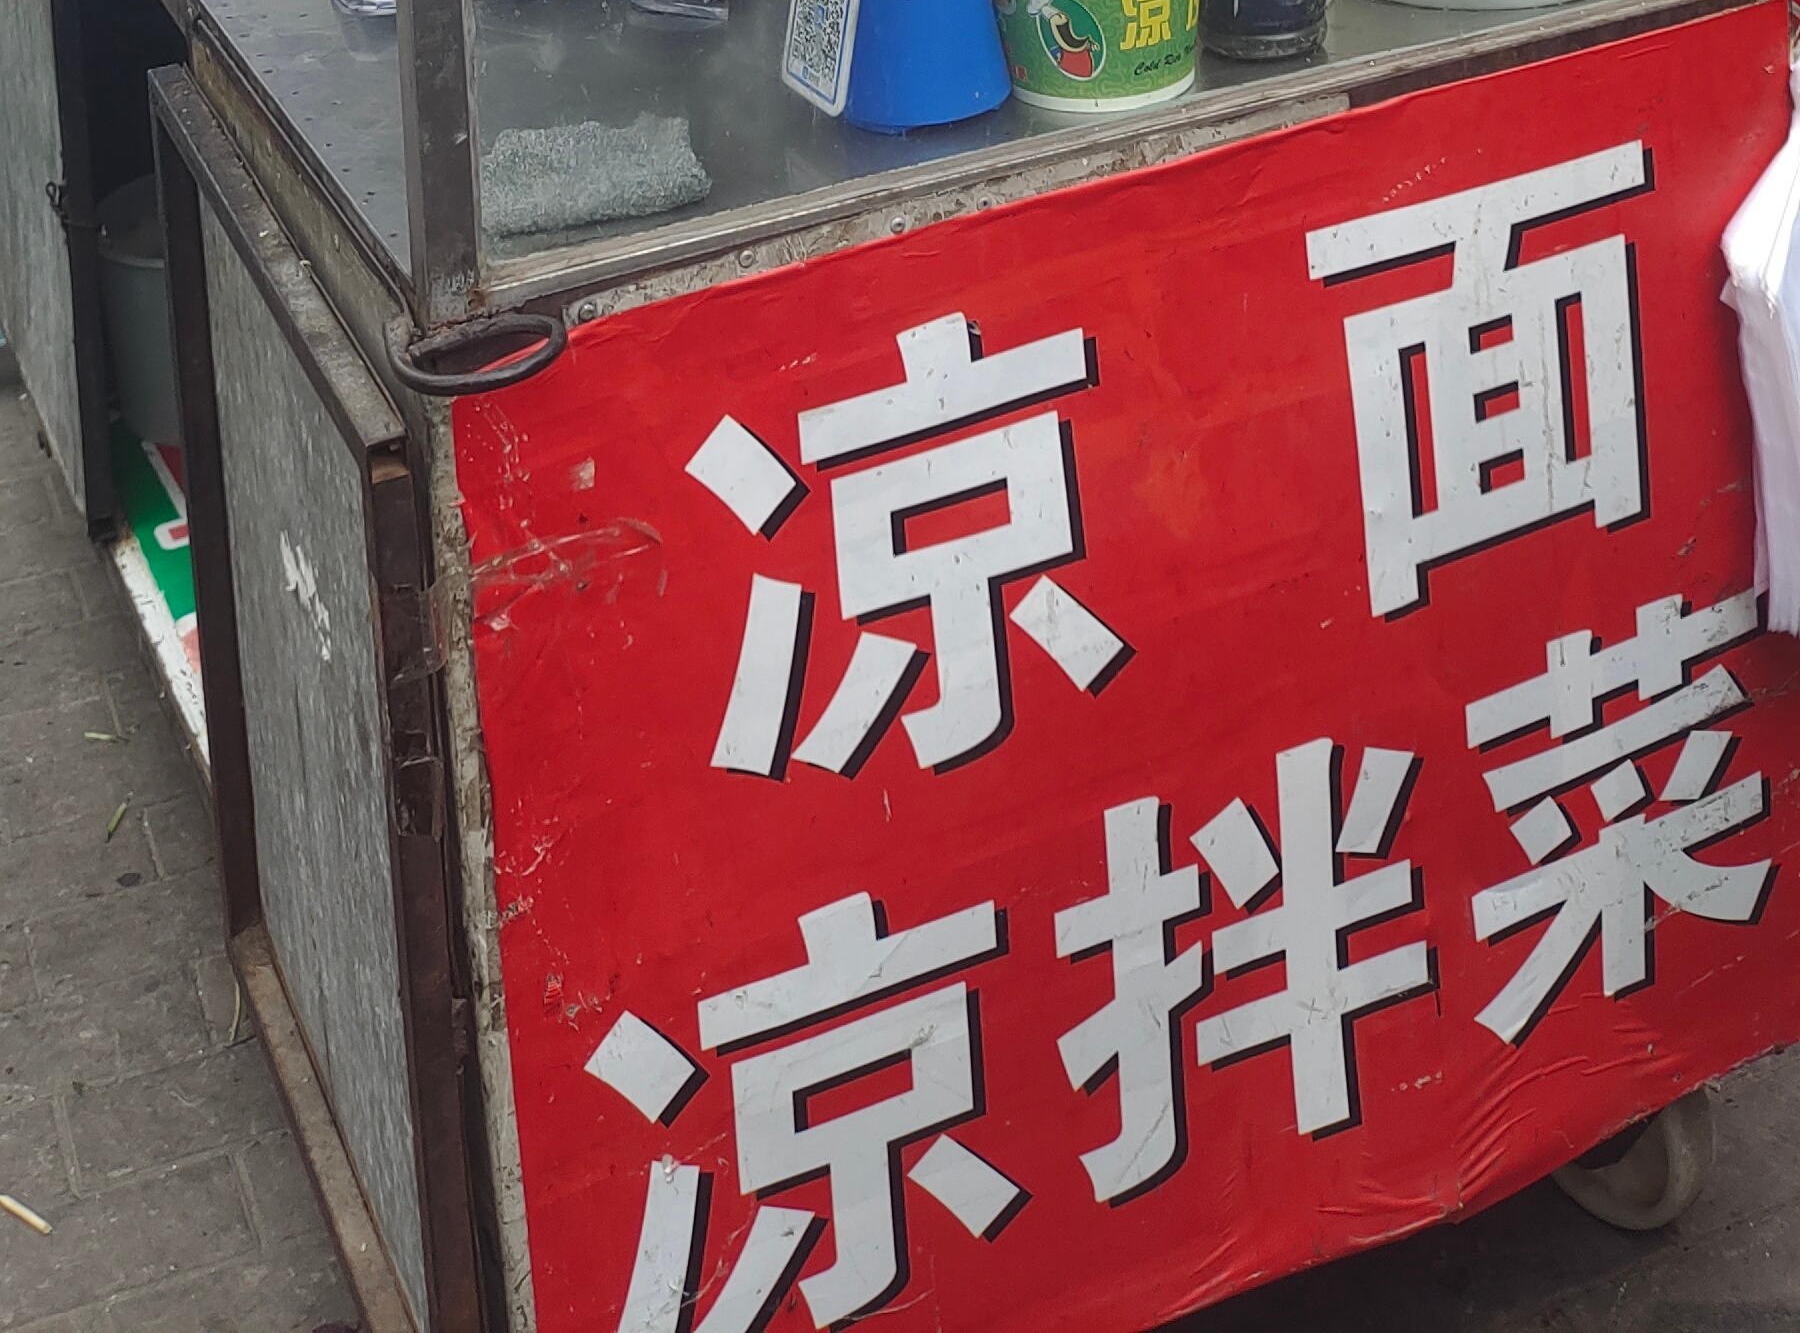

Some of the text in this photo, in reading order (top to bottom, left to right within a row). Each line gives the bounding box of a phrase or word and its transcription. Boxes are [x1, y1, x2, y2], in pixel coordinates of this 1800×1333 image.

[685, 138, 1652, 780] 凉面
[584, 591, 1775, 1333] 凉拌菜
